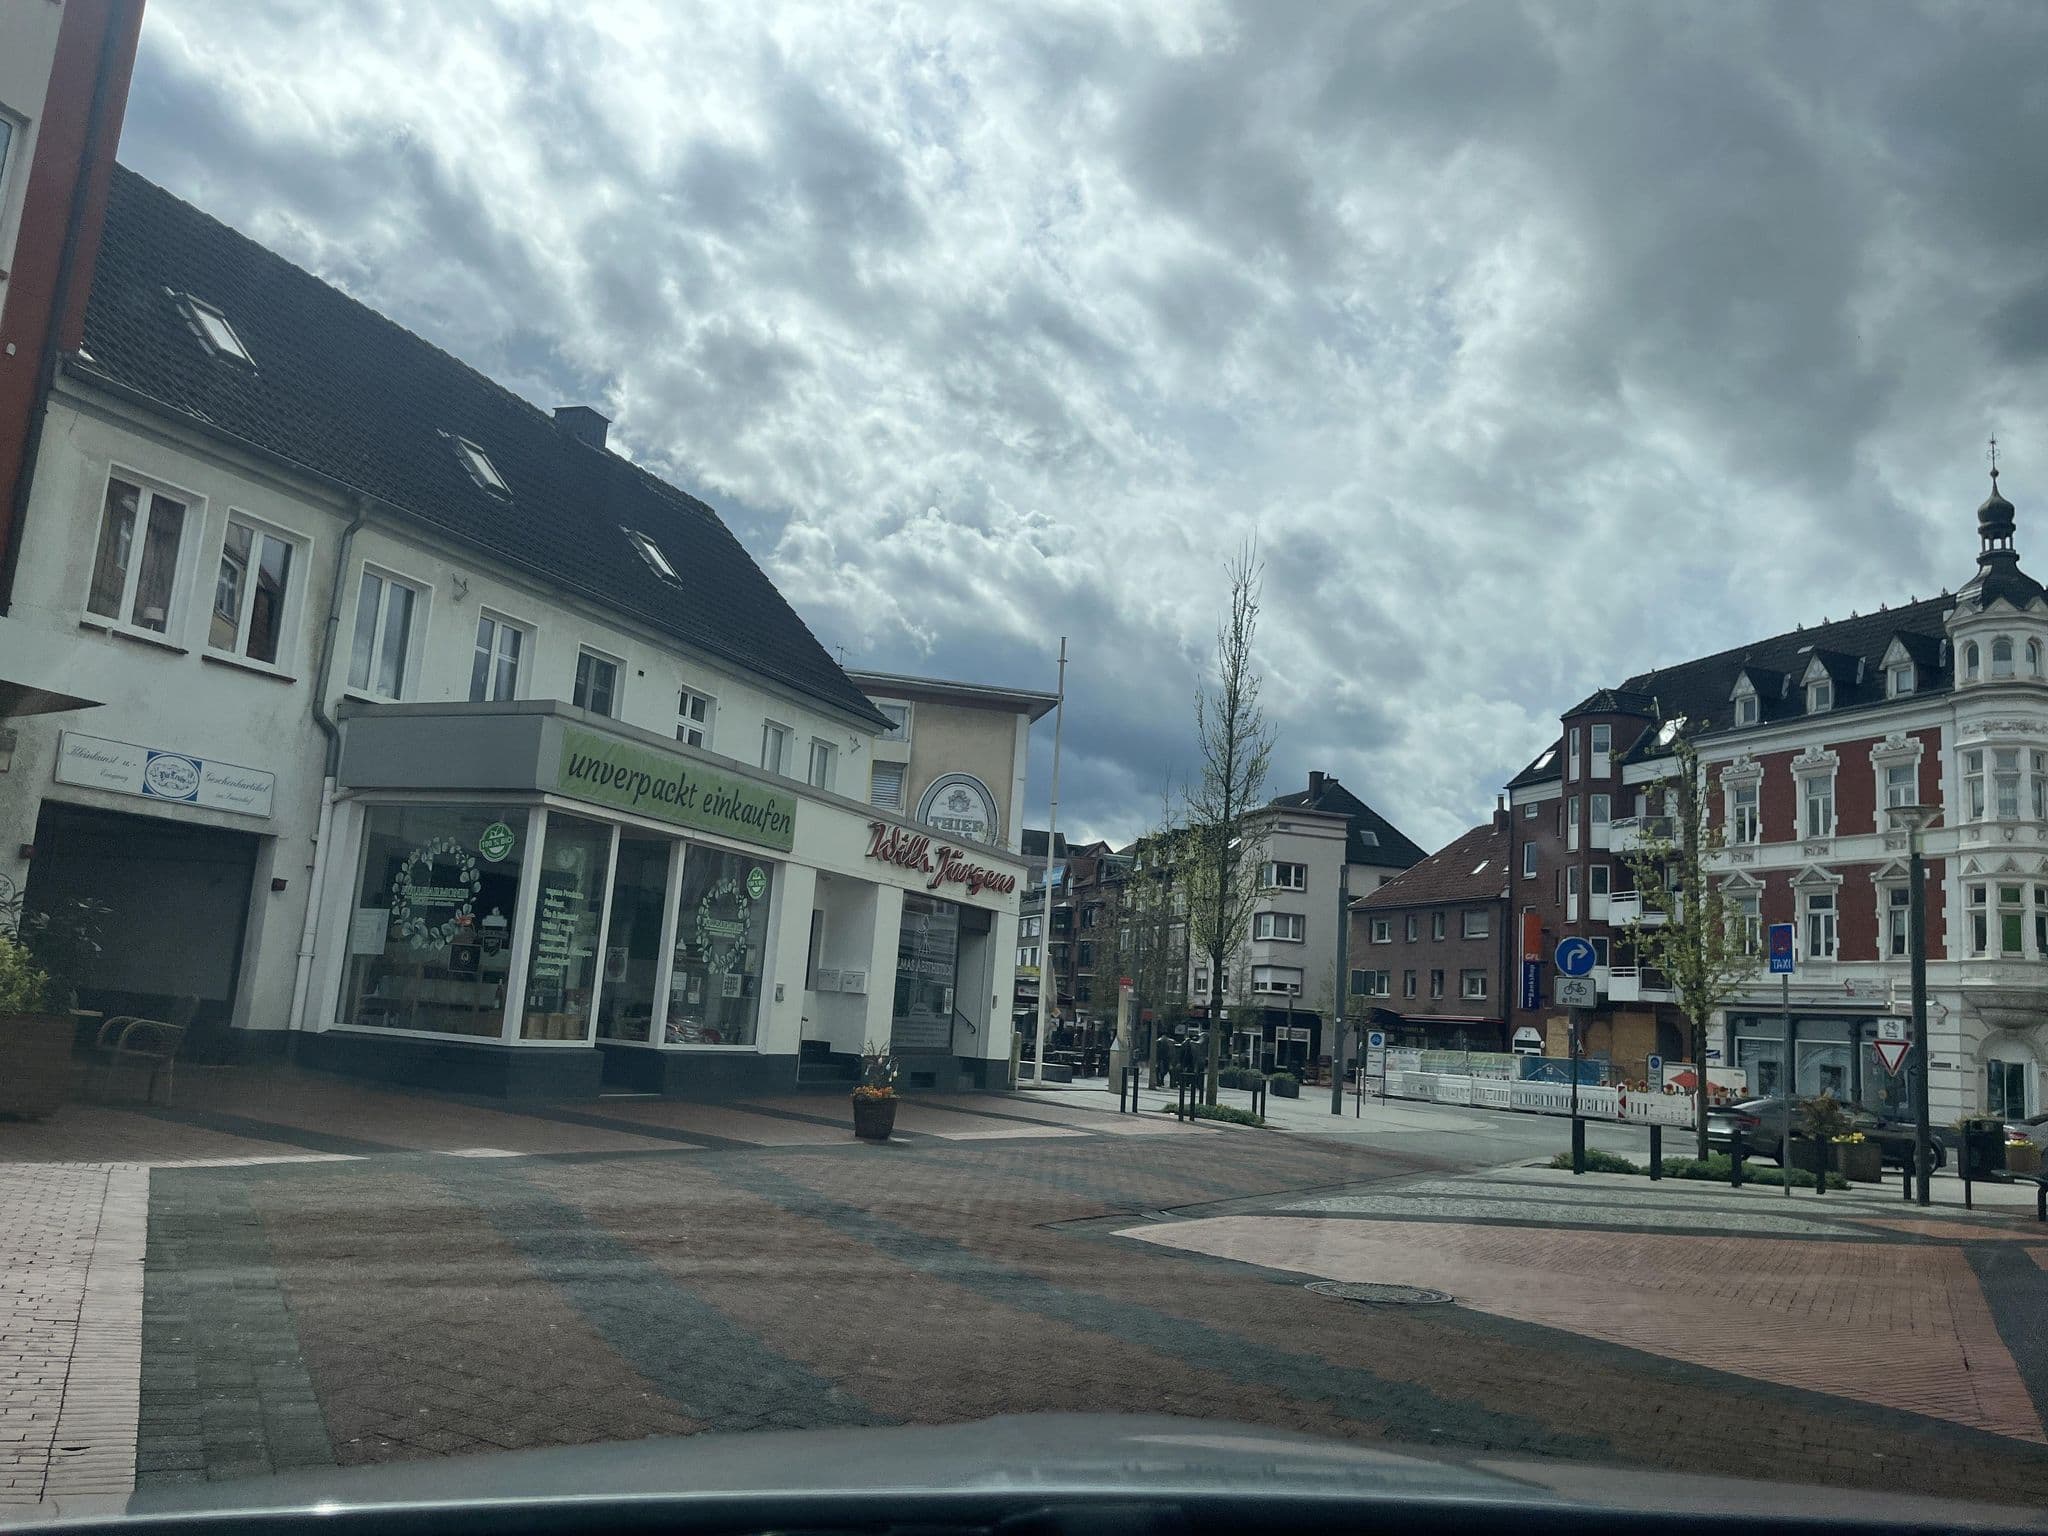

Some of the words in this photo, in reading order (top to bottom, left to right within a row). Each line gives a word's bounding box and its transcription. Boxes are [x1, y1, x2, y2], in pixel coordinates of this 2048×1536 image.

[568, 753, 698, 809] unverpackt
[703, 787, 791, 834] einkaufen
[930, 816, 984, 833] THIER
[927, 846, 1016, 895] Jürgens
[1771, 959, 1791, 970] TAXI
